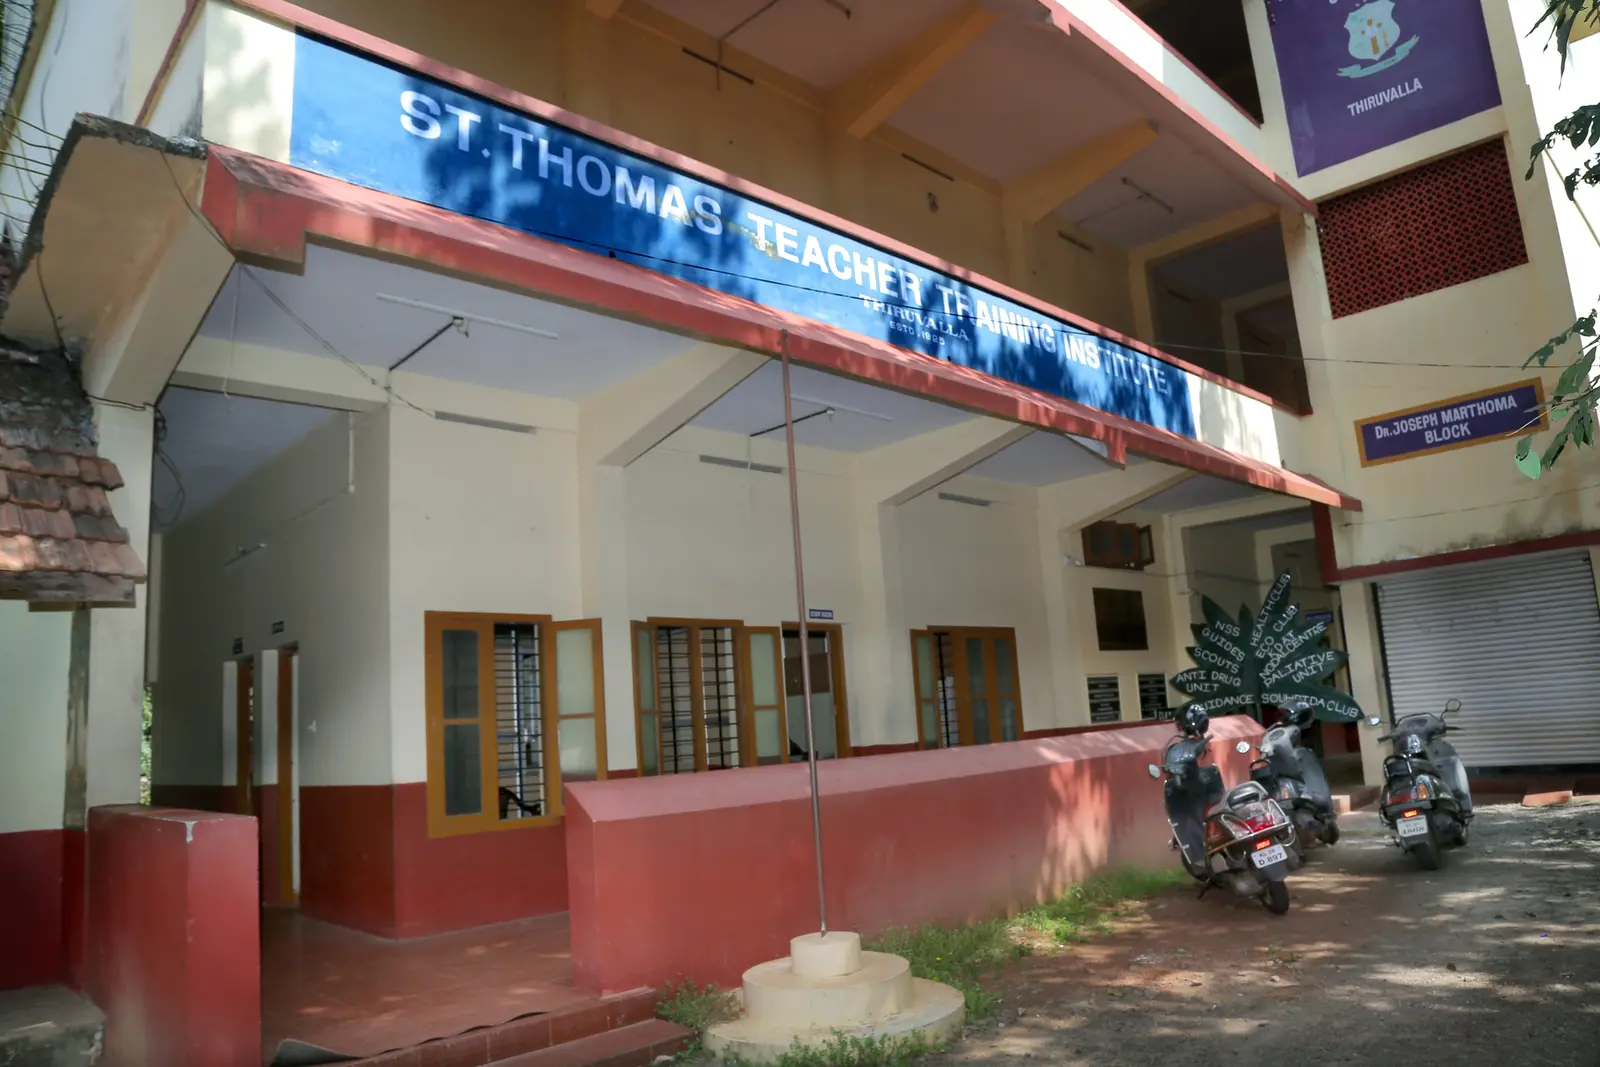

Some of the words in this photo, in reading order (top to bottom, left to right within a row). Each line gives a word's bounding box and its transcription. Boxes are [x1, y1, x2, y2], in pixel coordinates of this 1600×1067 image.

[1347, 78, 1423, 117] THIRUVALLA
[747, 212, 922, 306] TEACHER
[936, 284, 1057, 353] TRAINING
[1064, 332, 1168, 394] INSTITUTE
[859, 294, 970, 342] THIRUVALLA
[1441, 395, 1518, 425] MARTHOMA
[1424, 422, 1472, 444] BLOCK
[1215, 620, 1241, 637] NSS
[1255, 636, 1274, 659] ECO
[1273, 605, 1298, 632] CLUB
[1201, 627, 1245, 662] GUIDES
[1194, 647, 1240, 675] SCOUTS
[1263, 651, 1334, 688] PALIATIVE
[1292, 662, 1324, 684] UNIT
[1176, 670, 1207, 683] ANTI
[1211, 670, 1242, 687] DRUG
[1186, 683, 1220, 693] UNIT
[1199, 694, 1255, 711] UIDANCE
